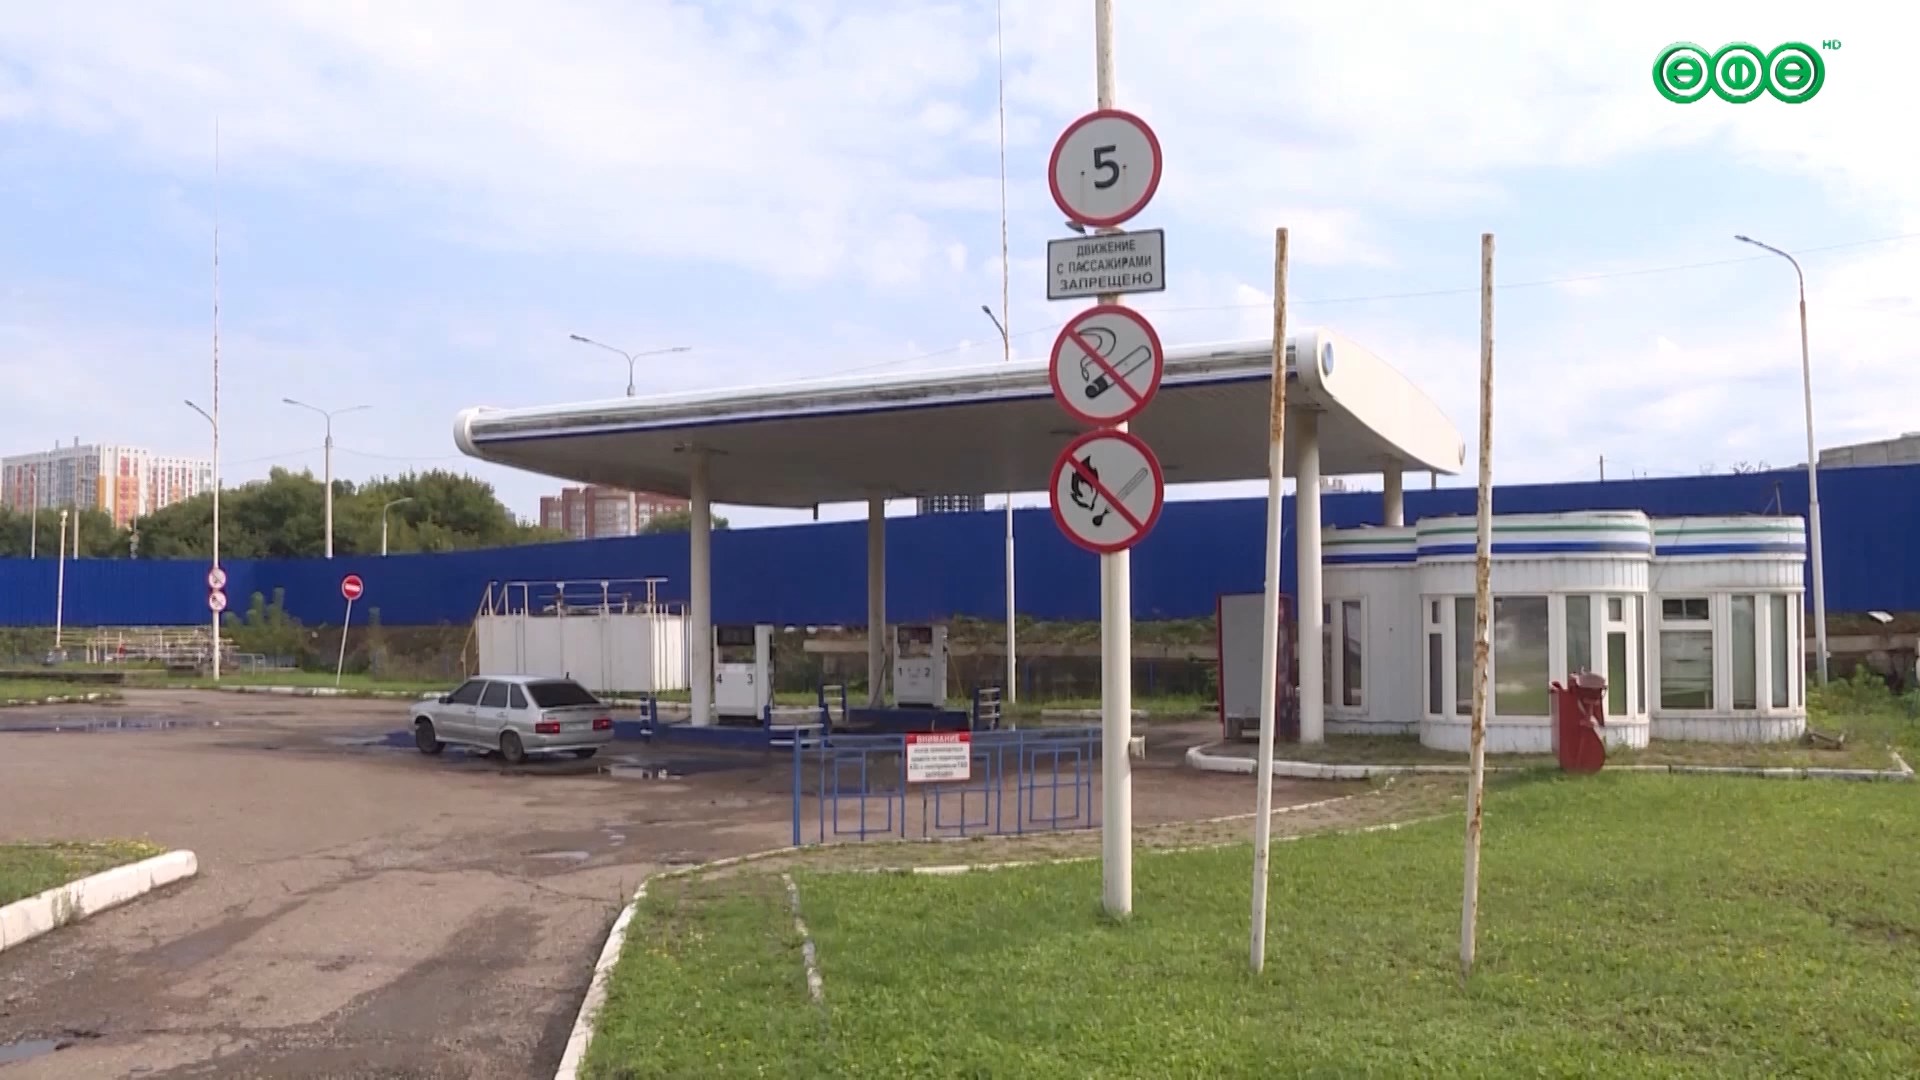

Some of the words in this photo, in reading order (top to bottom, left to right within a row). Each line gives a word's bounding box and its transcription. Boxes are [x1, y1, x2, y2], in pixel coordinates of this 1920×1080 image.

[1093, 145, 1120, 189] 5
[1076, 239, 1136, 257] ДВИЖЕНИЕ
[1056, 264, 1064, 275] С
[1068, 255, 1152, 274] ПАССАЖИРАМИ
[1060, 273, 1153, 291] ЗАПРЕЩЕНО
[715, 673, 722, 683] 4
[747, 673, 753, 684] 3
[916, 735, 960, 744] ВНИМАНИЕ
